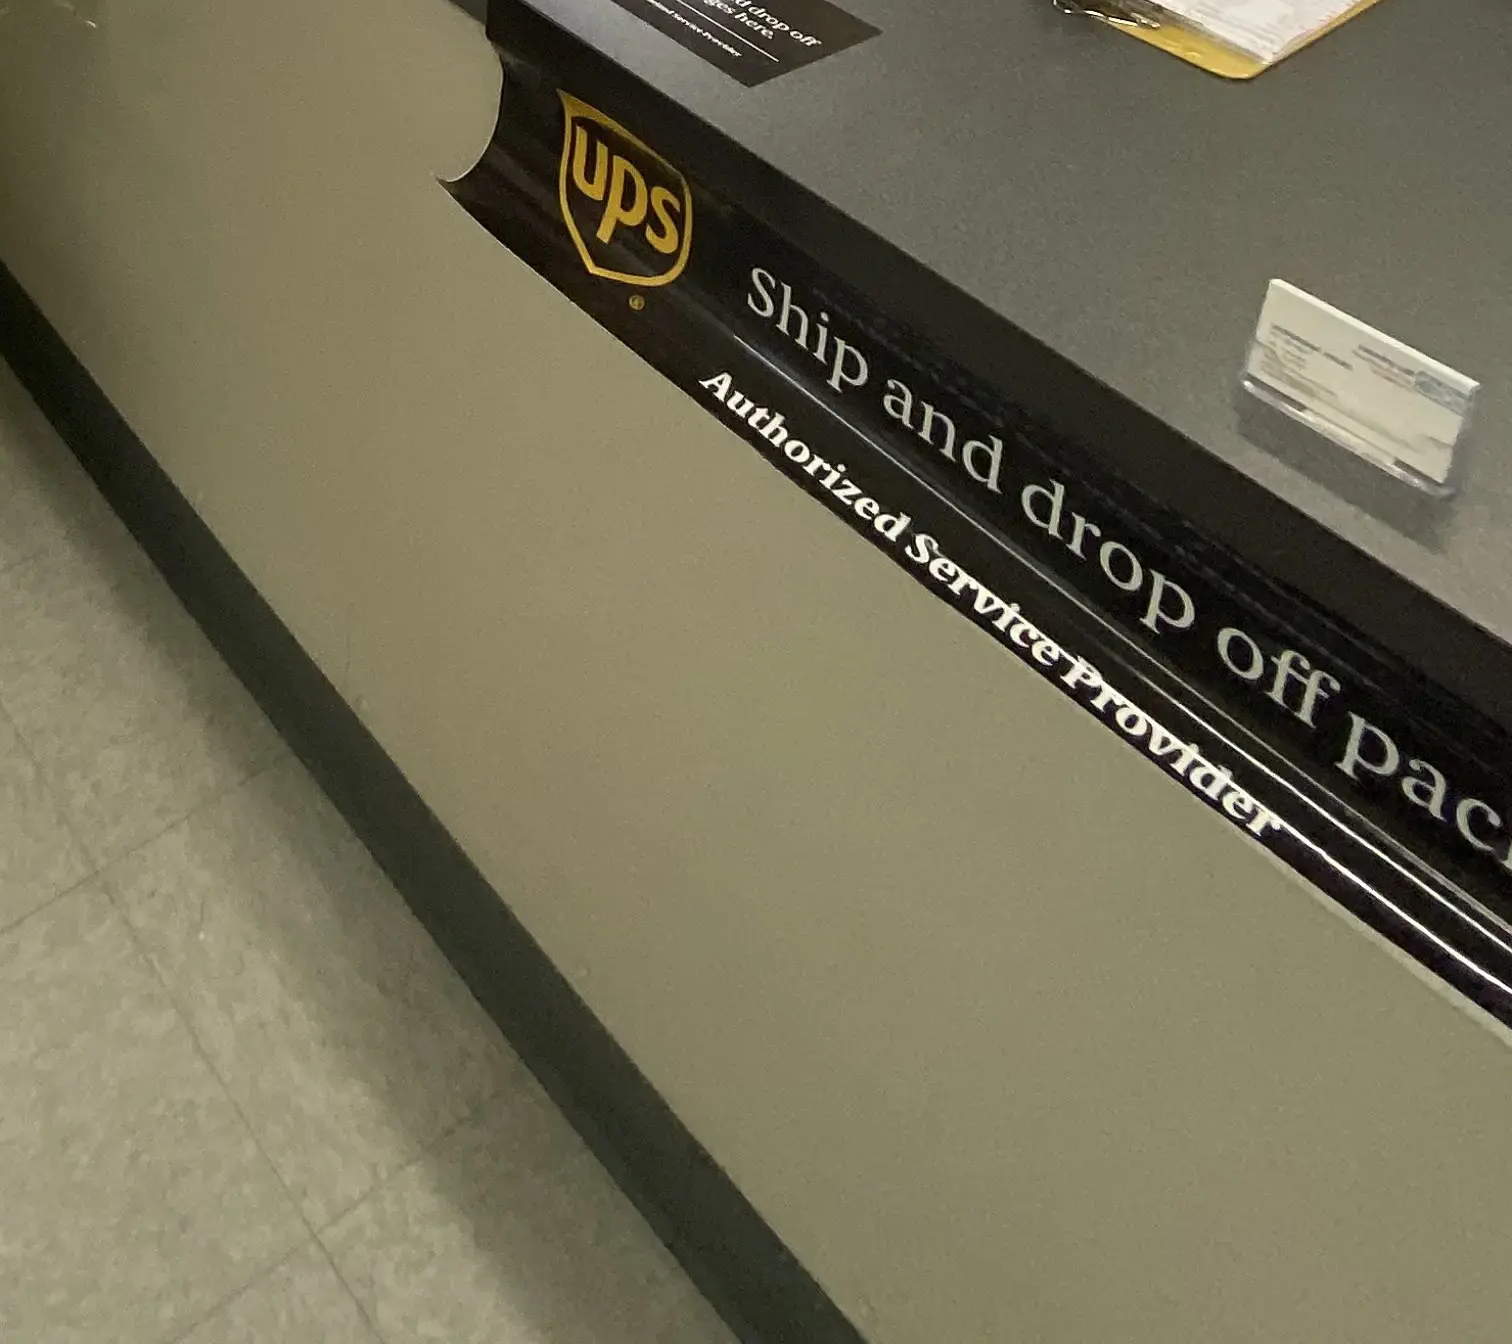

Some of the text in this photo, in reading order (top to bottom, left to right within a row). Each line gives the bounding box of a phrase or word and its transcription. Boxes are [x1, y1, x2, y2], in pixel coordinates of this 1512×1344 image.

[748, 5, 790, 33] drop
[790, 29, 823, 47] off
[572, 124, 681, 255] ups
[698, 370, 1283, 838] Authorized Service Provider
[746, 267, 1512, 875] Ship and drop off pac
